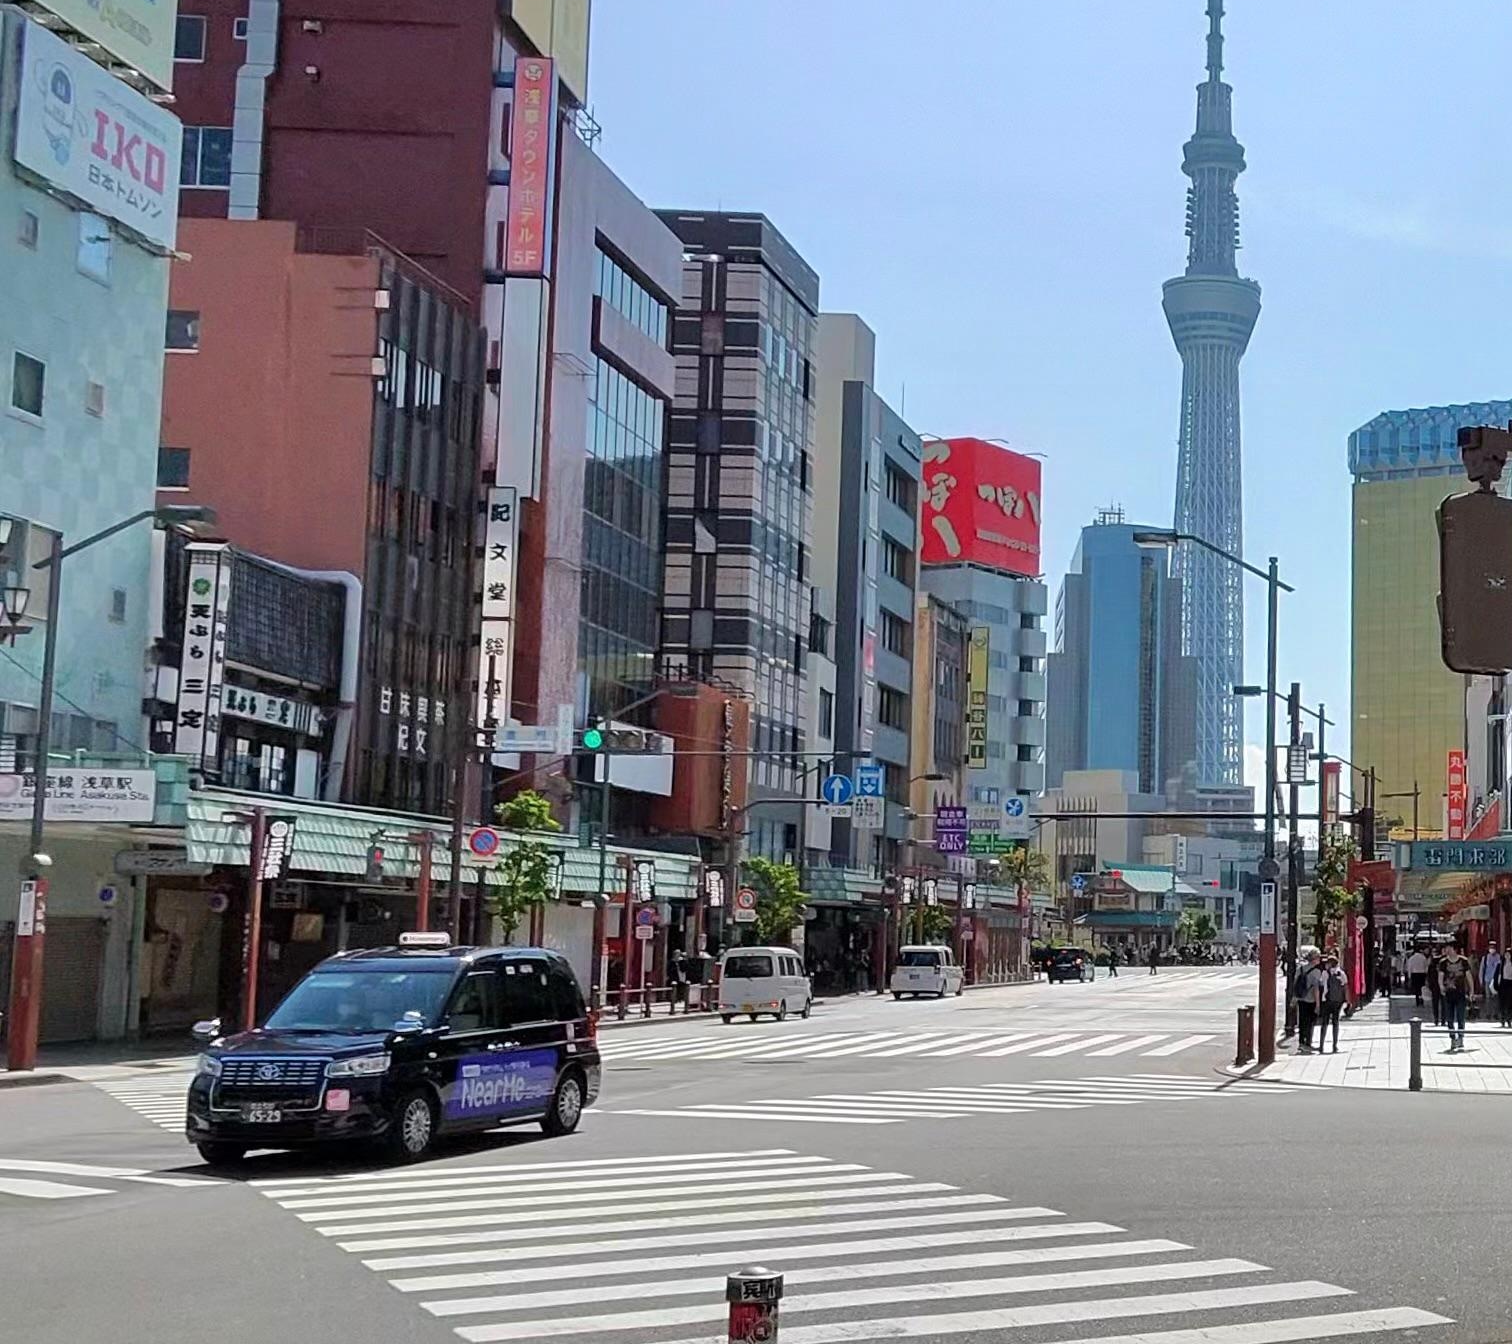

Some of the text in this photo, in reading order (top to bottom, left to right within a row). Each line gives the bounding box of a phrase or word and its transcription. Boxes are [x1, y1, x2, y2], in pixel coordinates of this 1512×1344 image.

[91, 108, 166, 196] IKO
[88, 163, 163, 219] 日本トムソン
[939, 842, 964, 851] ONLY
[461, 1073, 525, 1109] NearMe
